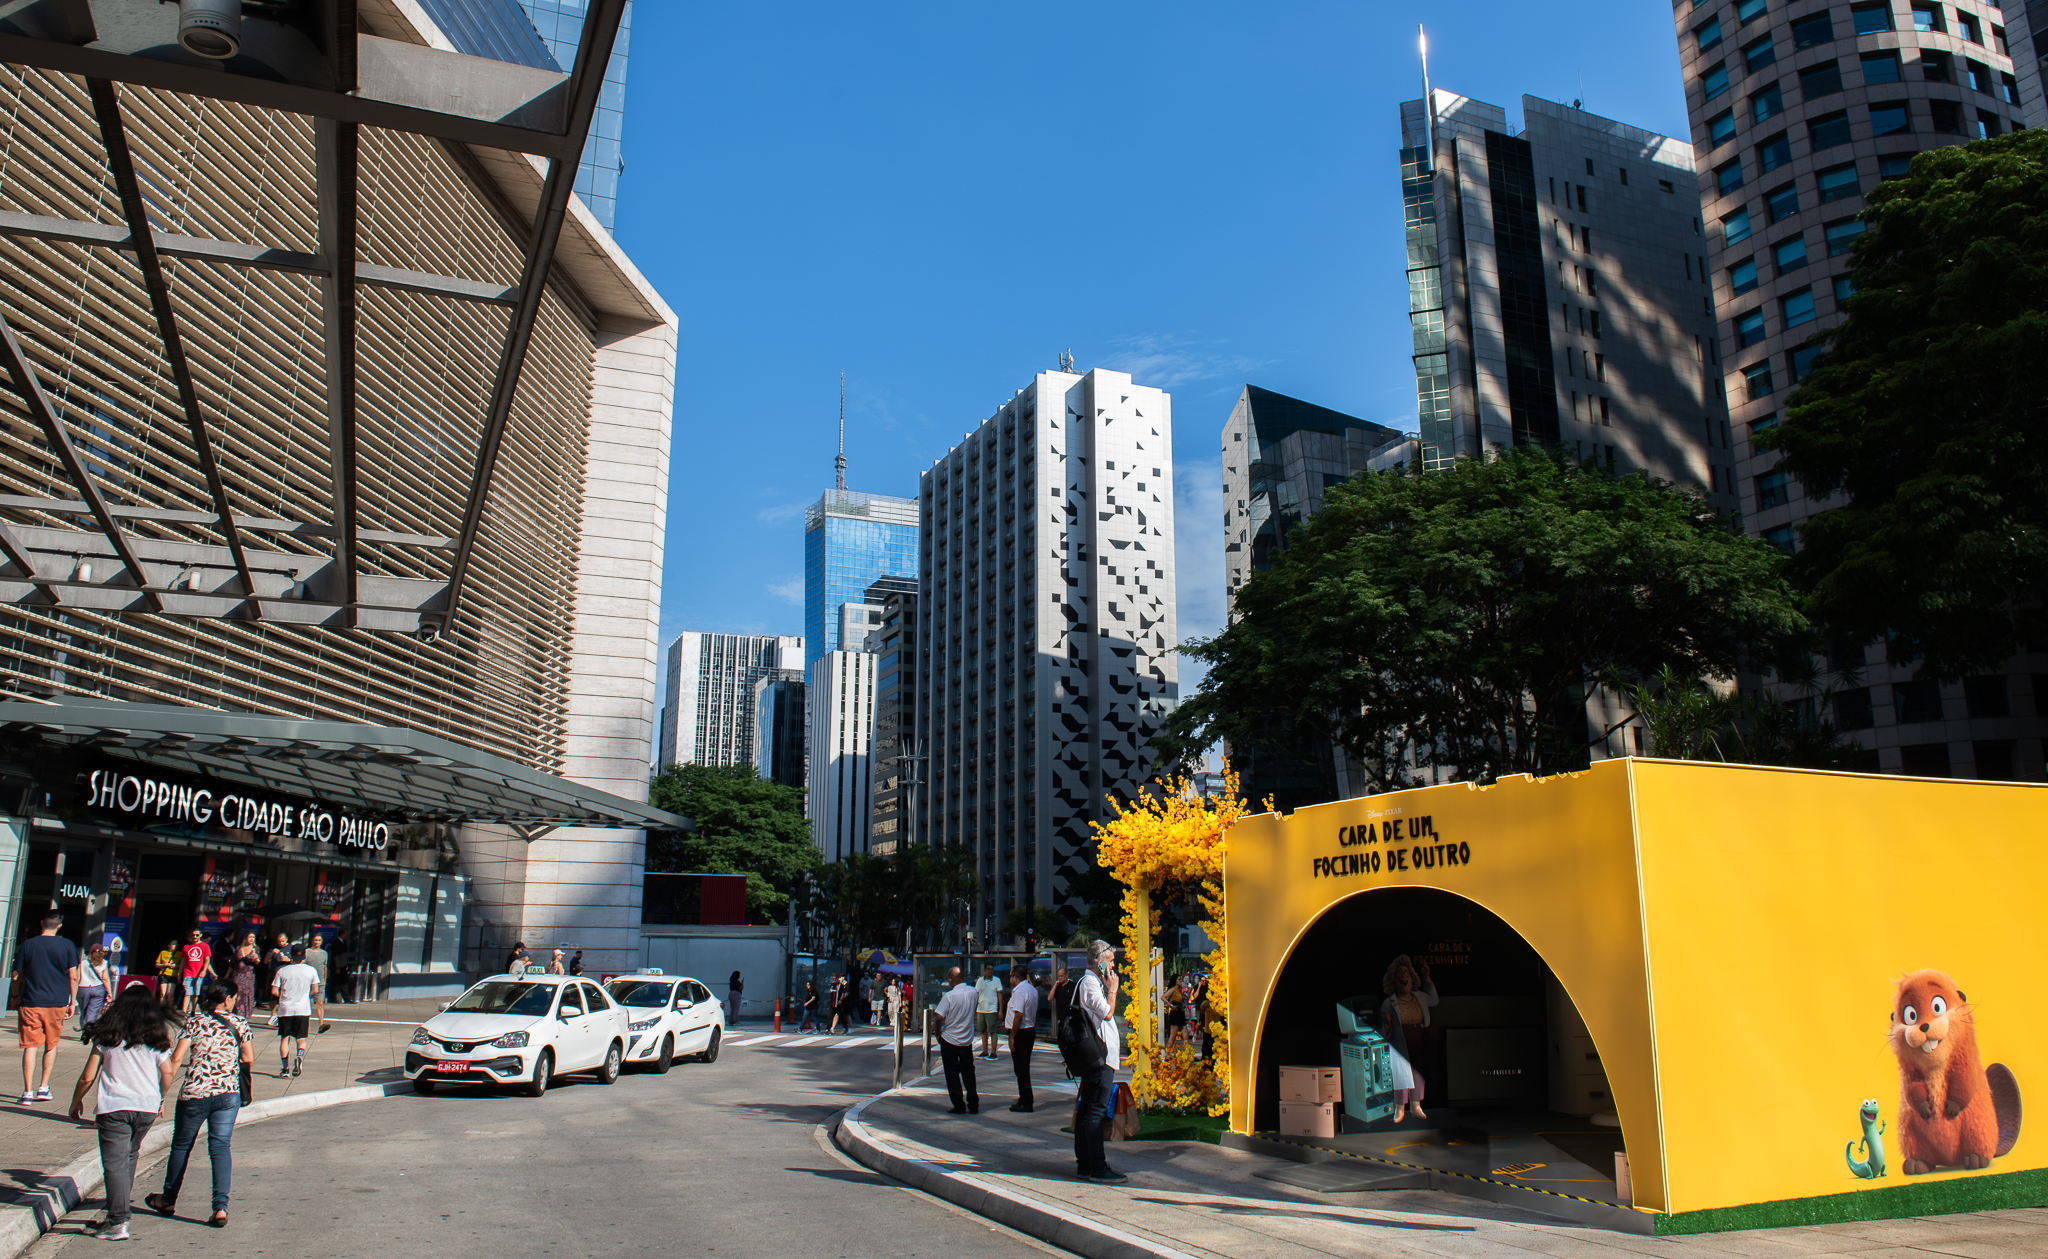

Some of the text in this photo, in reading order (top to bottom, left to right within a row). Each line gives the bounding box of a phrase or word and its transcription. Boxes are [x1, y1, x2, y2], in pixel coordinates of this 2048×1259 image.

[86, 769, 389, 851] SHOPPING CIDADE SÃO PAULO
[1384, 807, 1402, 816] PIXAR
[1338, 815, 1439, 848] CARA DE UM,
[1313, 841, 1471, 879] FOCINHO DE OUTRO
[1428, 942, 1451, 953] CARA
